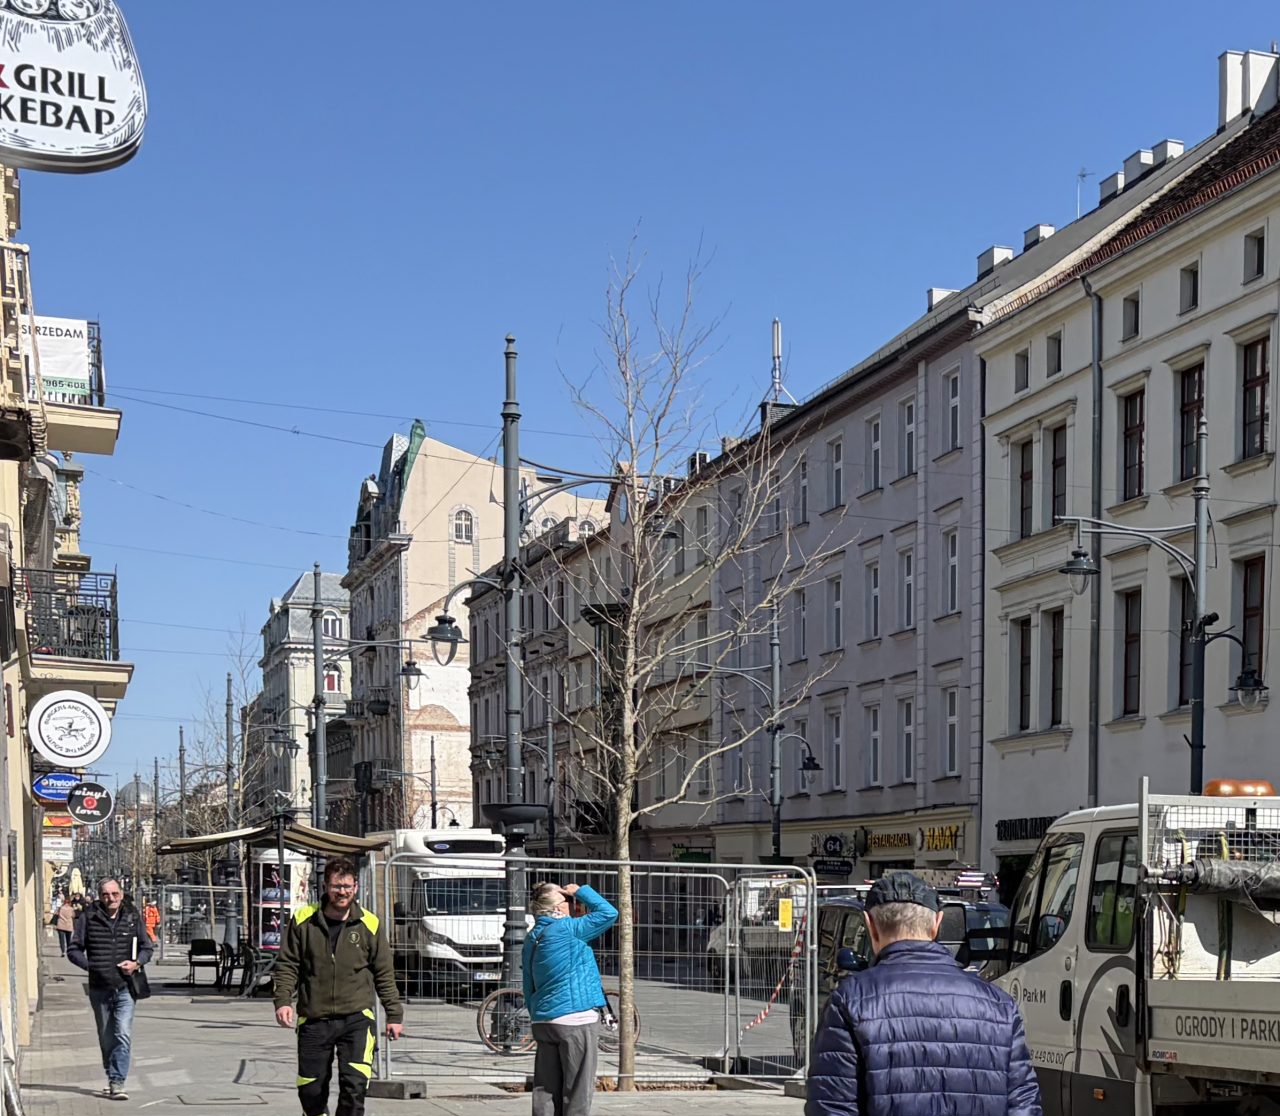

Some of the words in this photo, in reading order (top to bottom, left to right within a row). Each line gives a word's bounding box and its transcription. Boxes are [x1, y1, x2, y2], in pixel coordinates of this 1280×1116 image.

[14, 63, 116, 104] GRILL
[0, 93, 115, 135] KEBAP
[826, 840, 841, 851] 64
[1023, 988, 1038, 1003] Park
[1039, 989, 1046, 1003] M
[1174, 1015, 1226, 1038] OGRODY
[1231, 1018, 1235, 1040] I
[1240, 1018, 1280, 1042] PARKI
[1152, 1050, 1178, 1062] ROMCAR
